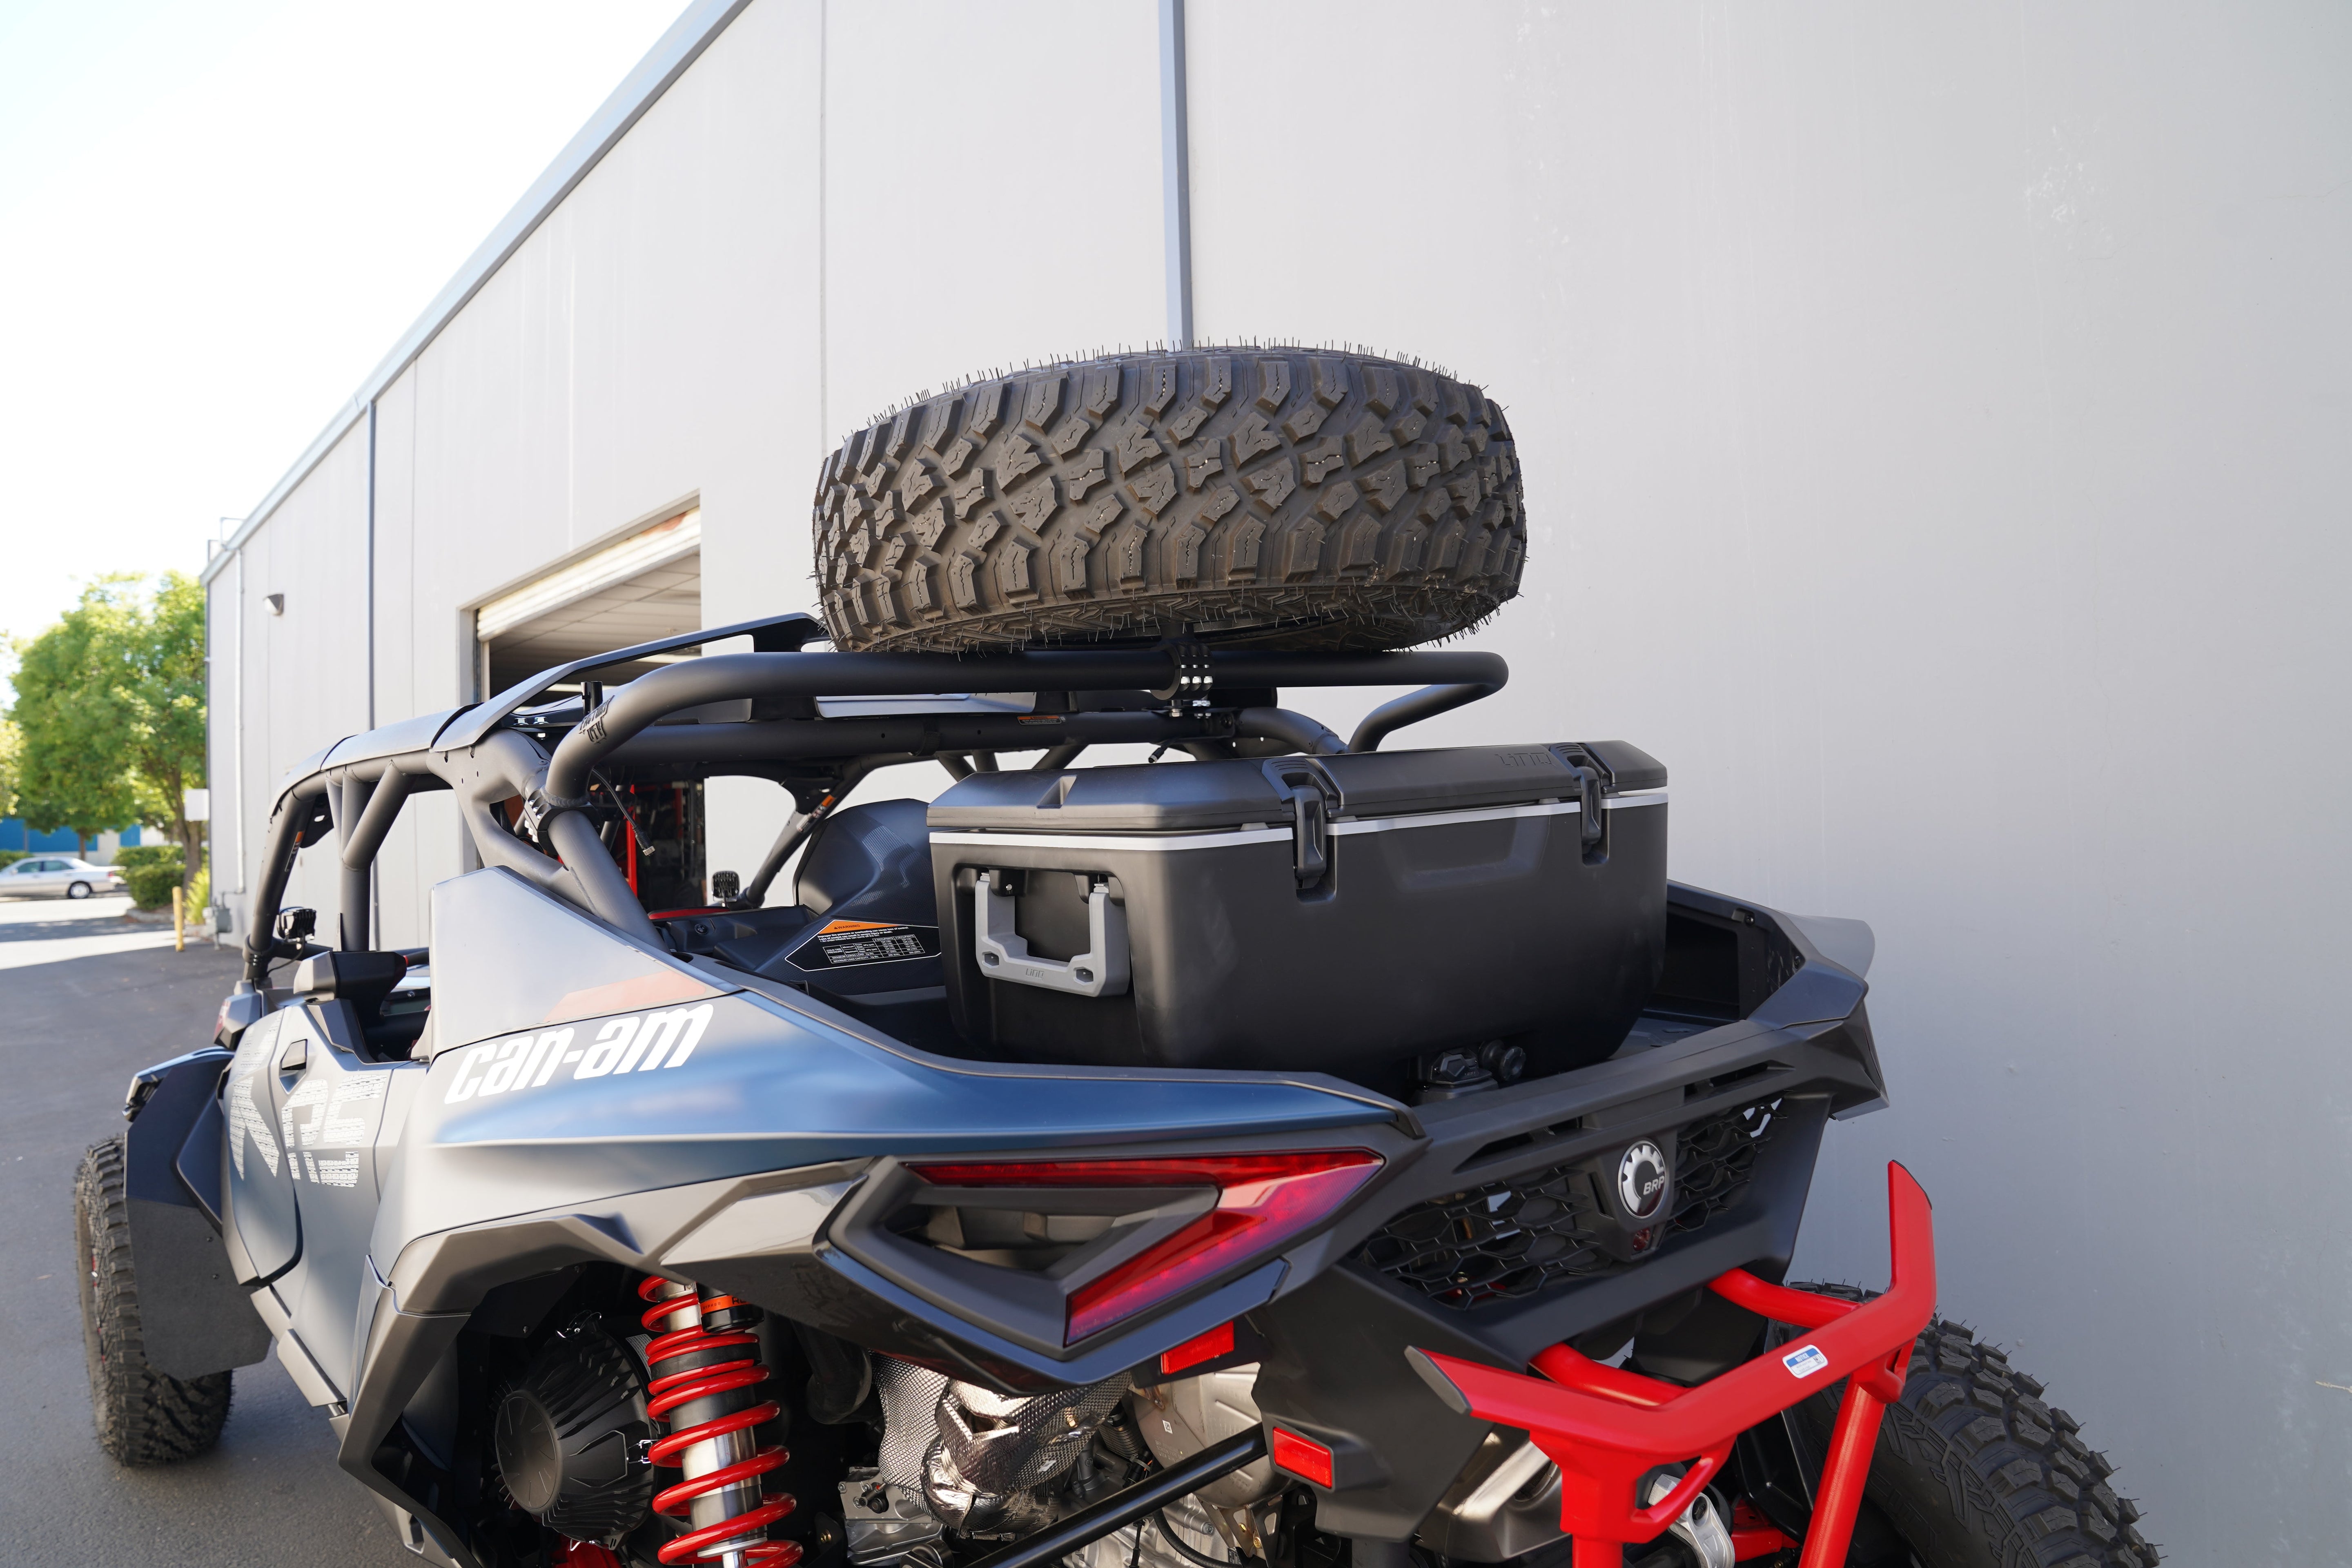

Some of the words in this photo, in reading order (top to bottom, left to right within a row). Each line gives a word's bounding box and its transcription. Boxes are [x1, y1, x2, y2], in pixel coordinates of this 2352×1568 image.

[444, 1004, 714, 1105] can-am
[1643, 1175, 1665, 1196] BRP
[1794, 1352, 1810, 1363] NOTICE
